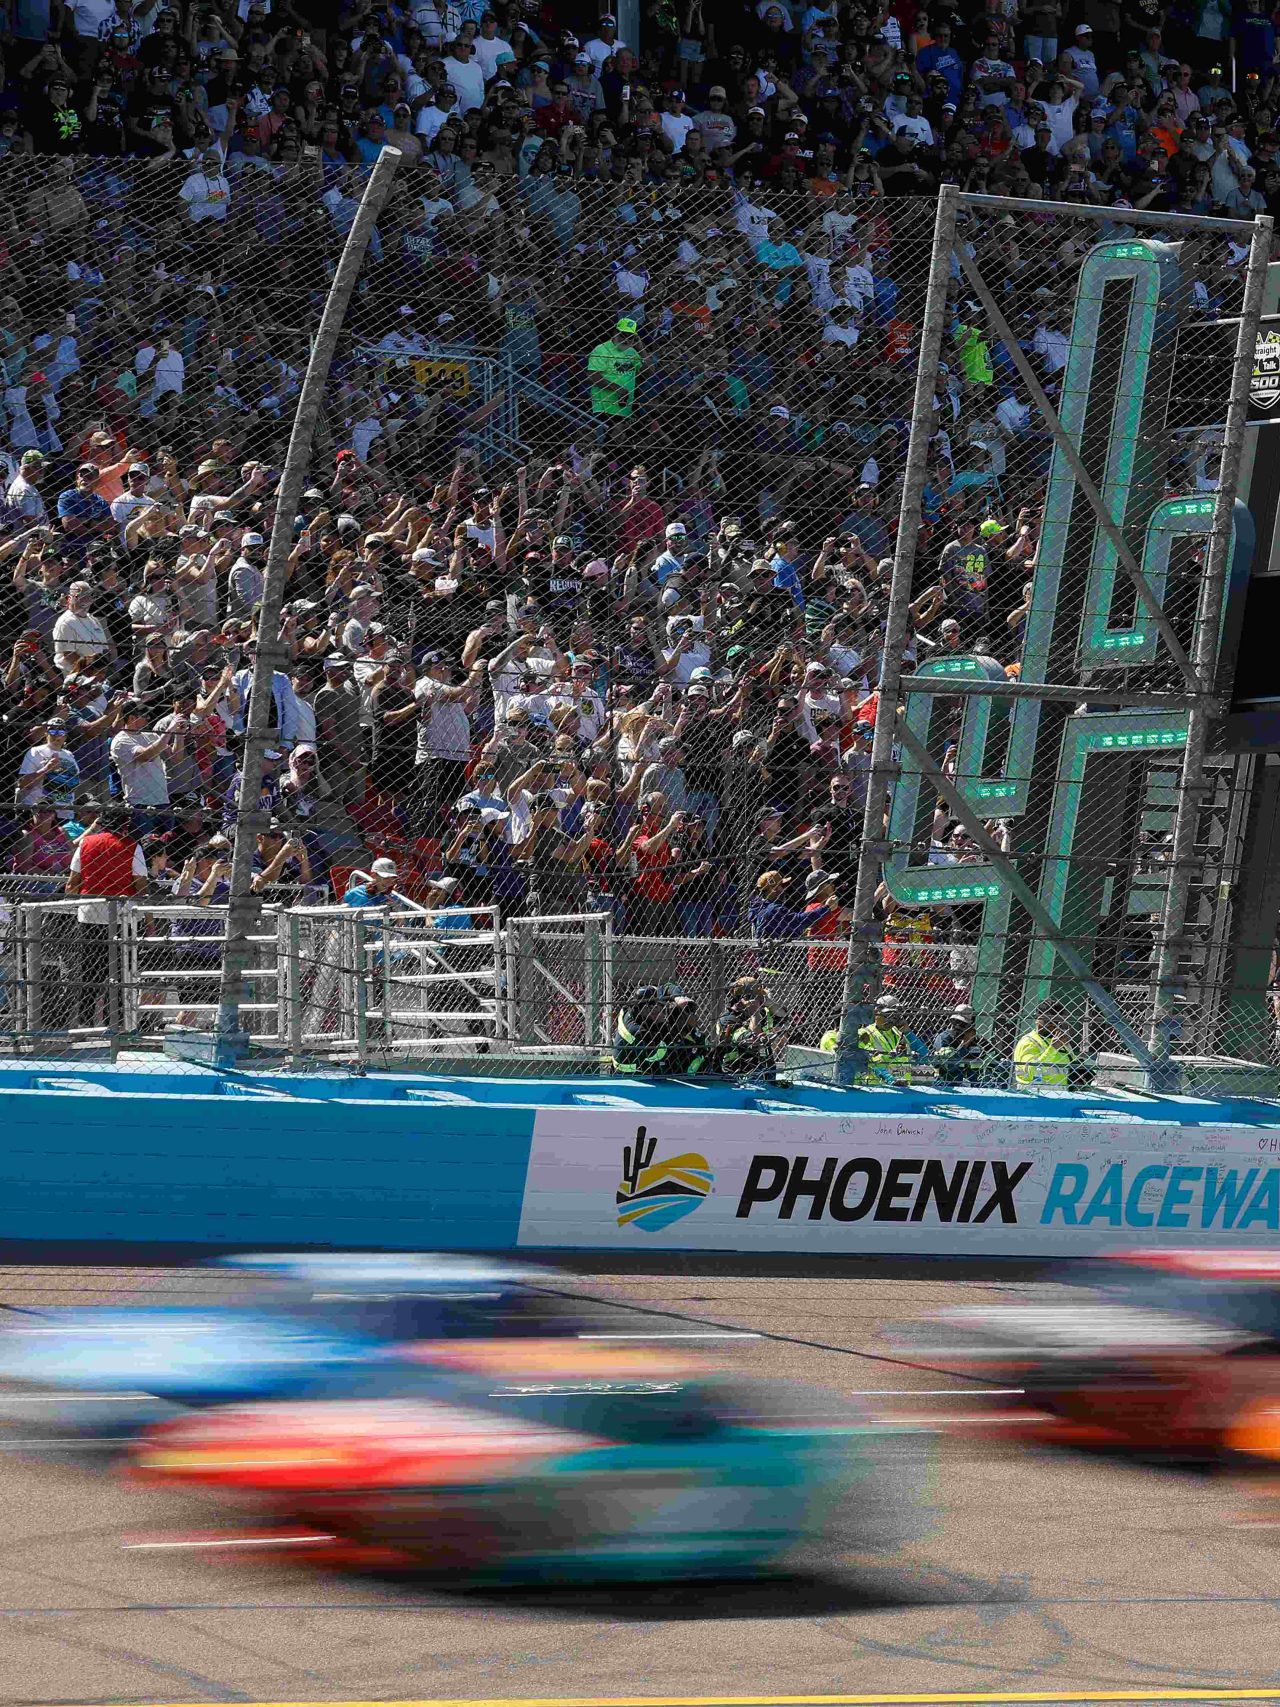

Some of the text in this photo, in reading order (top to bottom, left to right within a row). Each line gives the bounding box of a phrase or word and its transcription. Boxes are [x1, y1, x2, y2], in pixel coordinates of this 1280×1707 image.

[1255, 345, 1277, 356] traight
[1262, 360, 1277, 370] Talk
[1250, 375, 1279, 390] 500
[966, 554, 985, 573] 24
[735, 1154, 1034, 1224] PHOENIX
